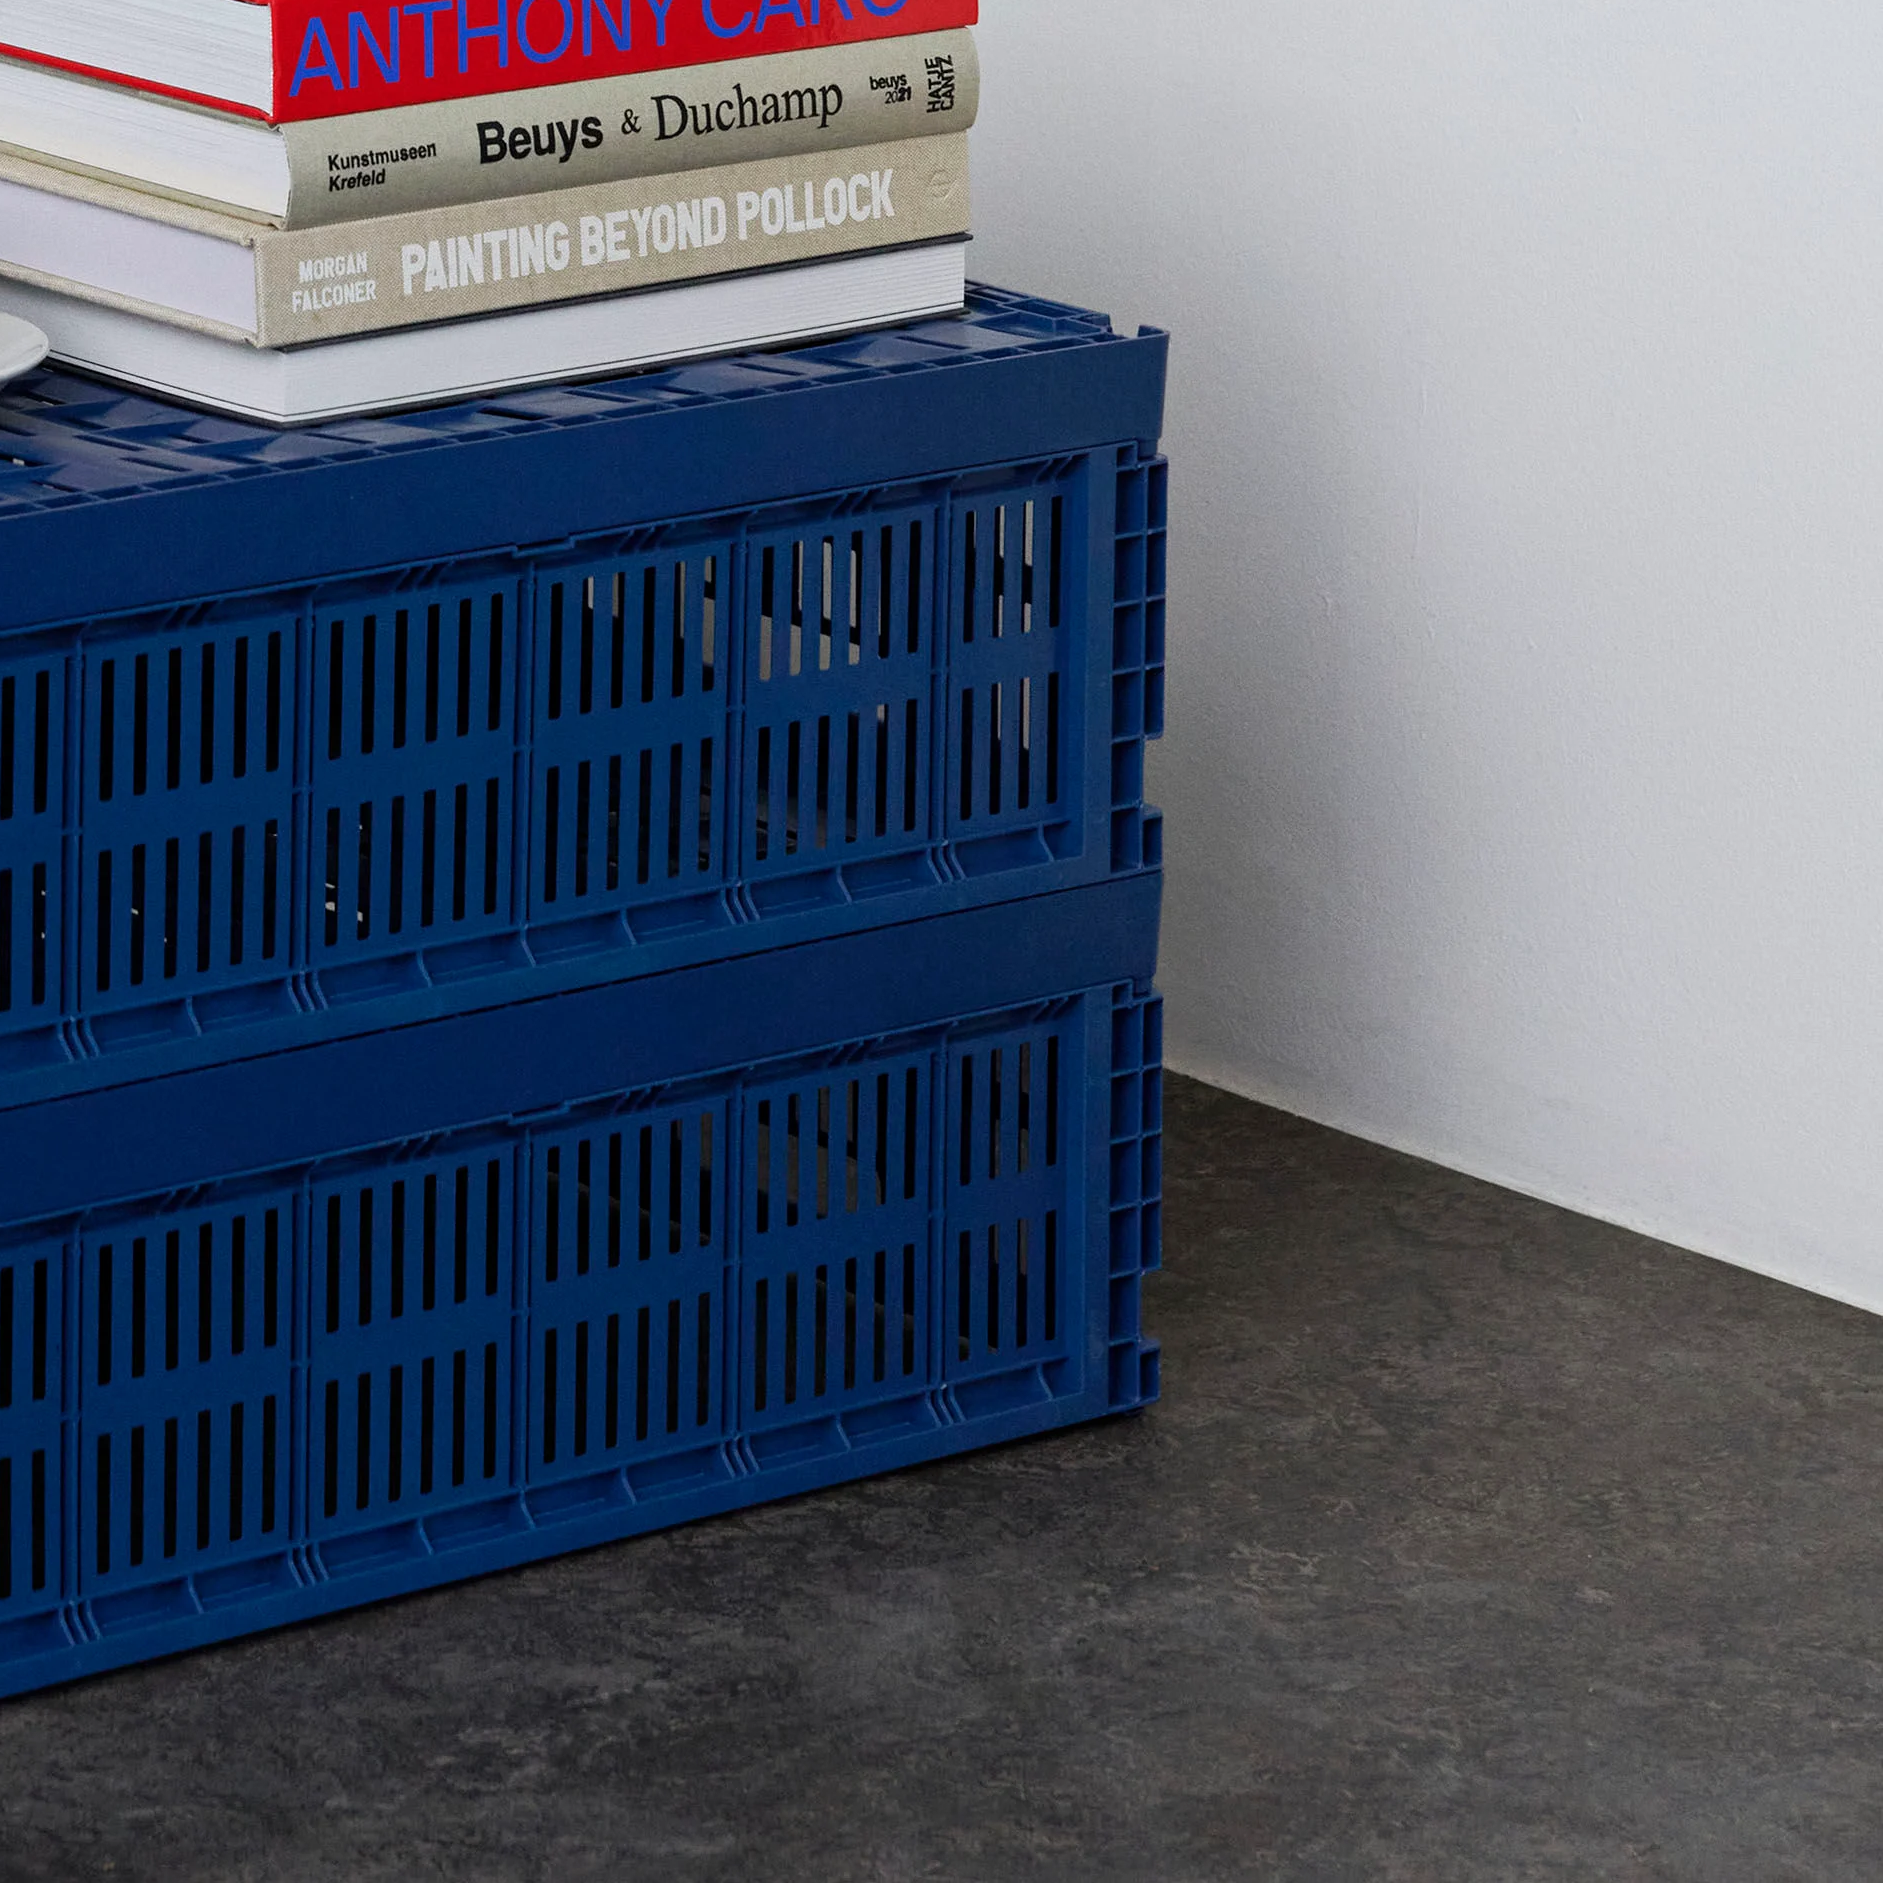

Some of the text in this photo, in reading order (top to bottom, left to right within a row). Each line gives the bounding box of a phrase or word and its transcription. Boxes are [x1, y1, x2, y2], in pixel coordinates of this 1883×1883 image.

[869, 73, 908, 92] beuys
[884, 86, 912, 104] 2021
[924, 57, 941, 114] HATJE
[937, 53, 954, 112] CANTZ
[476, 83, 844, 164] Beuys & Duchamp
[327, 142, 437, 172] Kunstmuseen
[328, 168, 386, 192] Krefeld
[401, 168, 895, 296] PAINTING BEYOND POLLOCK
[298, 250, 368, 283] MORGAN
[291, 279, 377, 314] FALCONER
